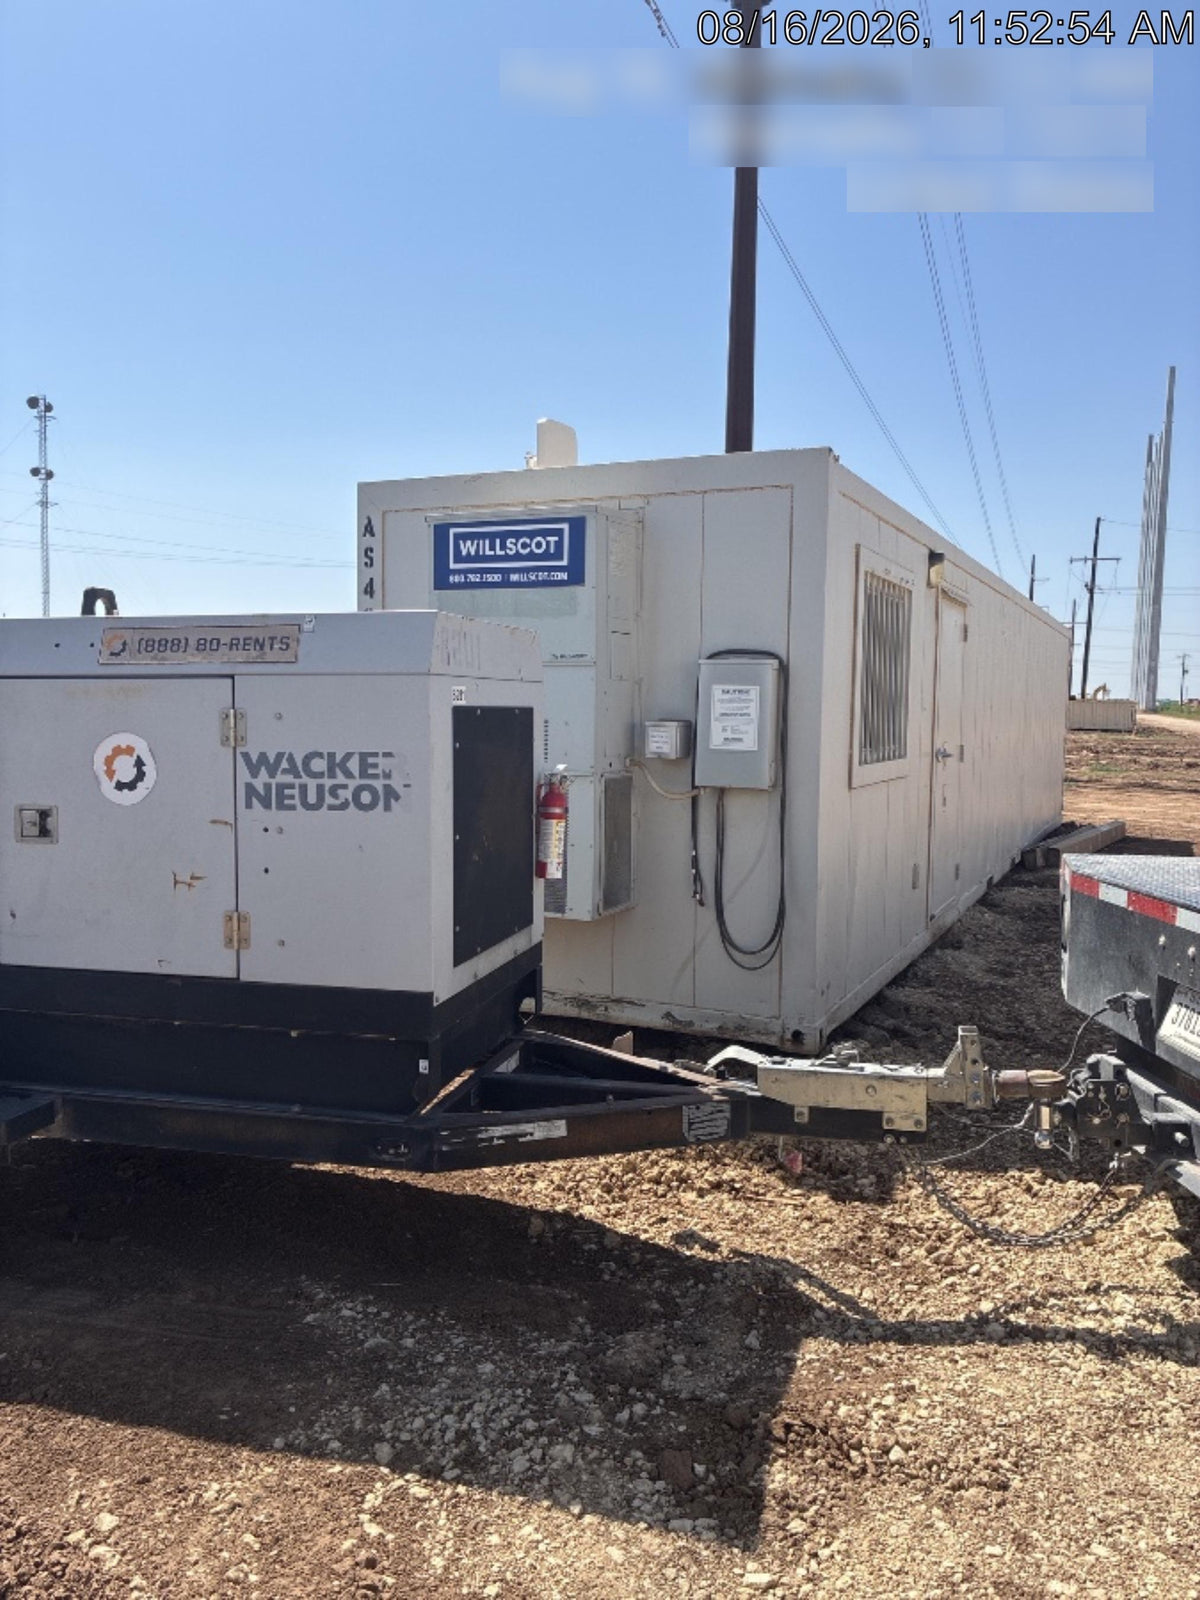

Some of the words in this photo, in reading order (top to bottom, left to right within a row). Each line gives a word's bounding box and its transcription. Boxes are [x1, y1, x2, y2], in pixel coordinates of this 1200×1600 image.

[459, 536, 559, 556] WILLSCOT
[362, 515, 376, 612] AS4
[137, 637, 189, 653] (888)
[195, 636, 291, 652] 80-RENTS
